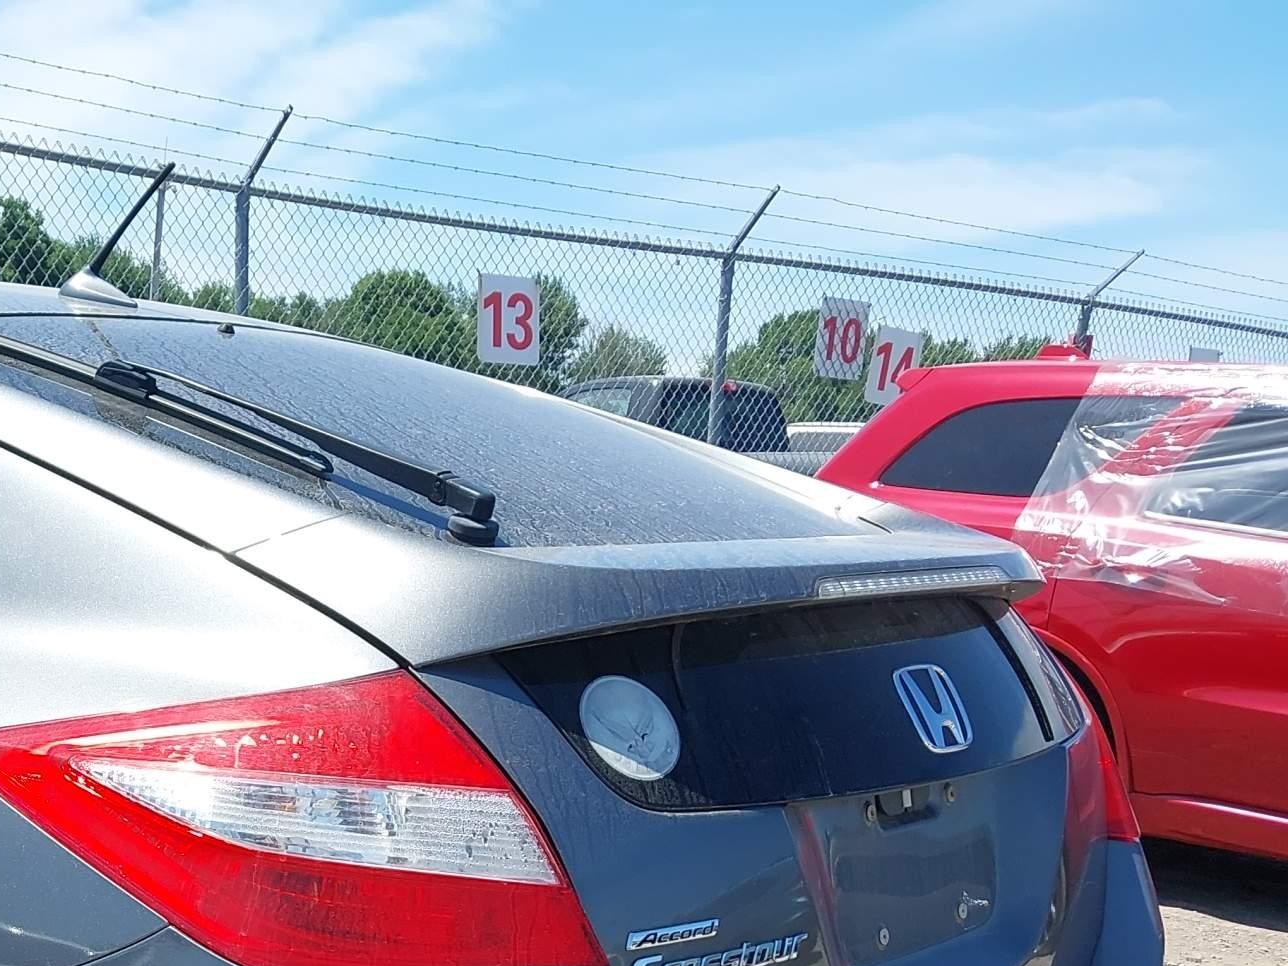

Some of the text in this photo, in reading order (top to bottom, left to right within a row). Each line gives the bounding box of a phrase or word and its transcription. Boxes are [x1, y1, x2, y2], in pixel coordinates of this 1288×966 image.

[483, 290, 534, 351] 13
[823, 315, 862, 364] 10
[876, 341, 914, 394] 14
[633, 921, 718, 948] Accord
